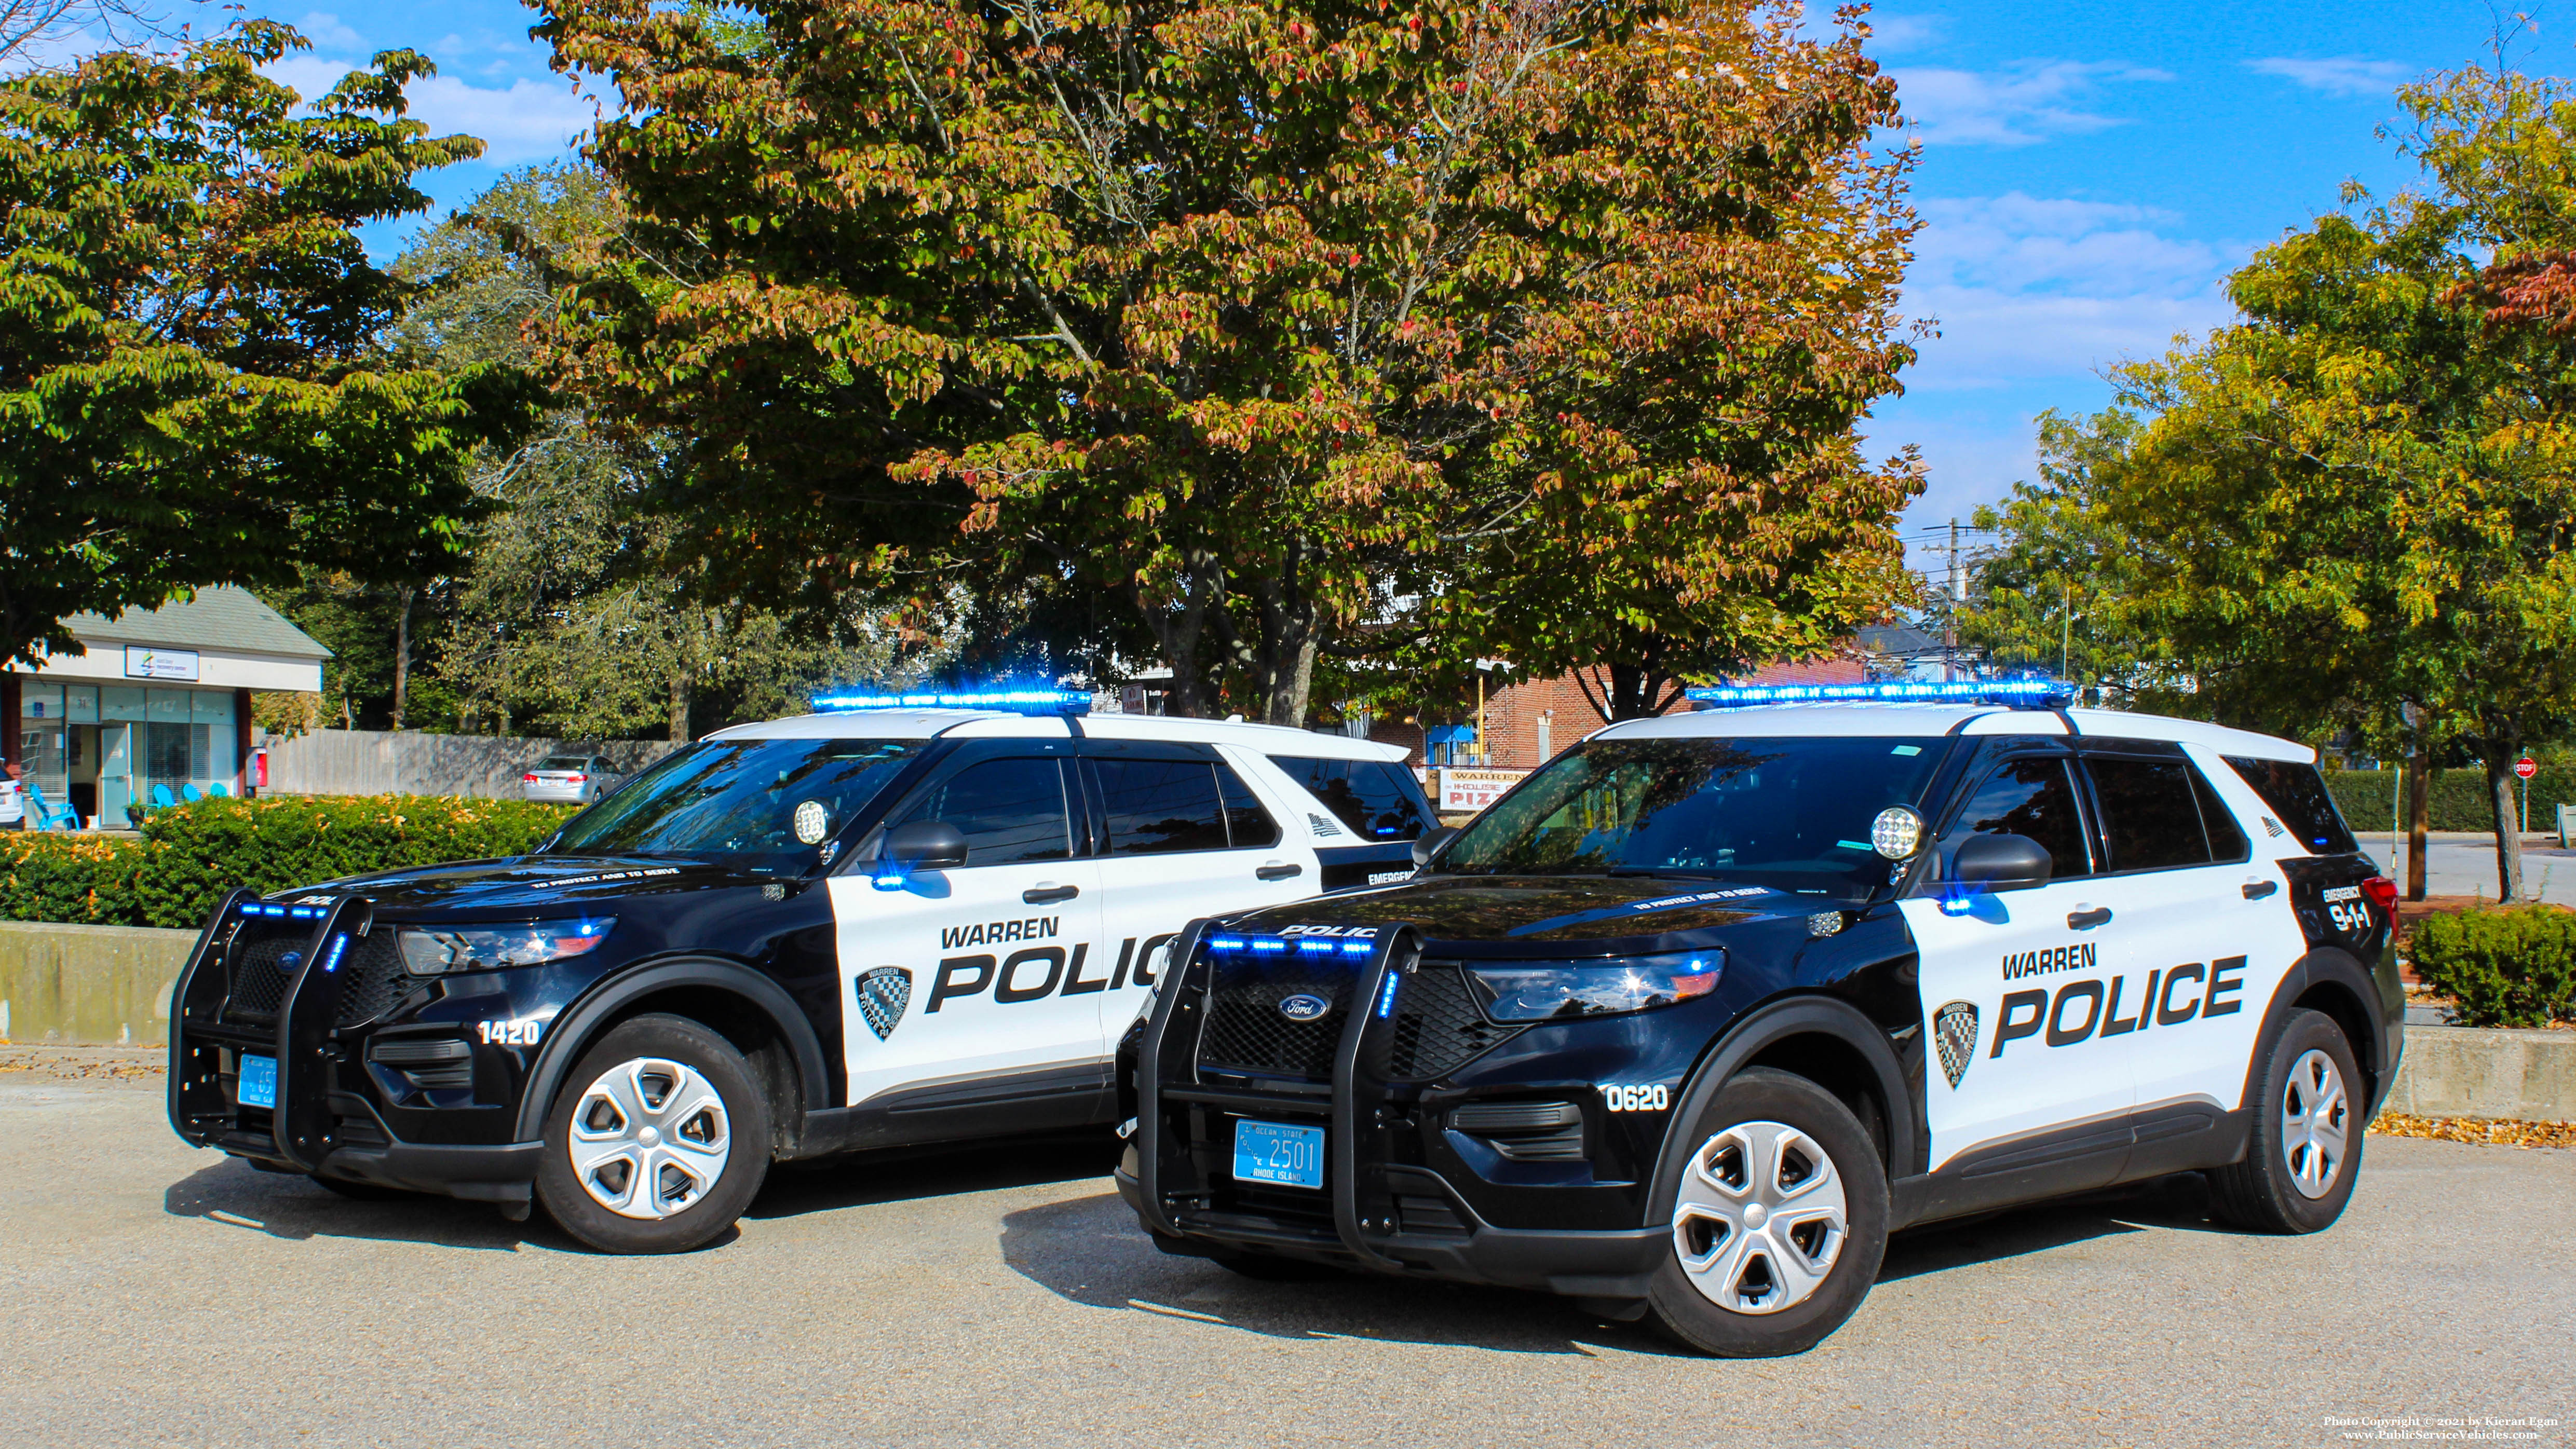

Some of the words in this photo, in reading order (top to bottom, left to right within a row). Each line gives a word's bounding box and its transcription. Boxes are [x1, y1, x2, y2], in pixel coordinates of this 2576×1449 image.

[1129, 689, 1136, 698] NO
[1123, 700, 1143, 710] PARKING
[550, 875, 599, 886] PROTECT
[643, 867, 680, 876] SERVE
[1650, 896, 1697, 907] PROTECT
[1696, 892, 1721, 901] AND
[1732, 887, 1769, 896] SERVE
[2323, 885, 2362, 903] EMERGENCY
[2328, 901, 2372, 932] 9-1-1
[942, 916, 1059, 949] WARREN
[1277, 925, 1378, 937] POLIC
[2002, 942, 2096, 980] WARREN
[868, 967, 899, 978] WARREN
[924, 933, 1181, 1014] POLIC
[859, 992, 880, 1031] POLICE
[888, 981, 911, 1030] DEPARTMENT
[1287, 999, 1314, 1015] Ford
[1943, 1003, 1968, 1015] WARREN
[1989, 954, 2247, 1059] POLICE
[478, 1020, 539, 1045] 1420
[879, 1028, 889, 1036] RI
[1936, 1033, 1953, 1078] POLICE
[1958, 1019, 1977, 1076] DEPARTMENT
[1951, 1076, 1959, 1085] RI
[1607, 1084, 1669, 1112] 0620
[1256, 1127, 1277, 1136] OCEAN
[1282, 1130, 1303, 1139] STATE
[1240, 1134, 1263, 1166] POLICE
[1269, 1139, 1313, 1171] 2501
[1253, 1168, 1275, 1179] RHODE
[1278, 1170, 1301, 1182] ISLAND
